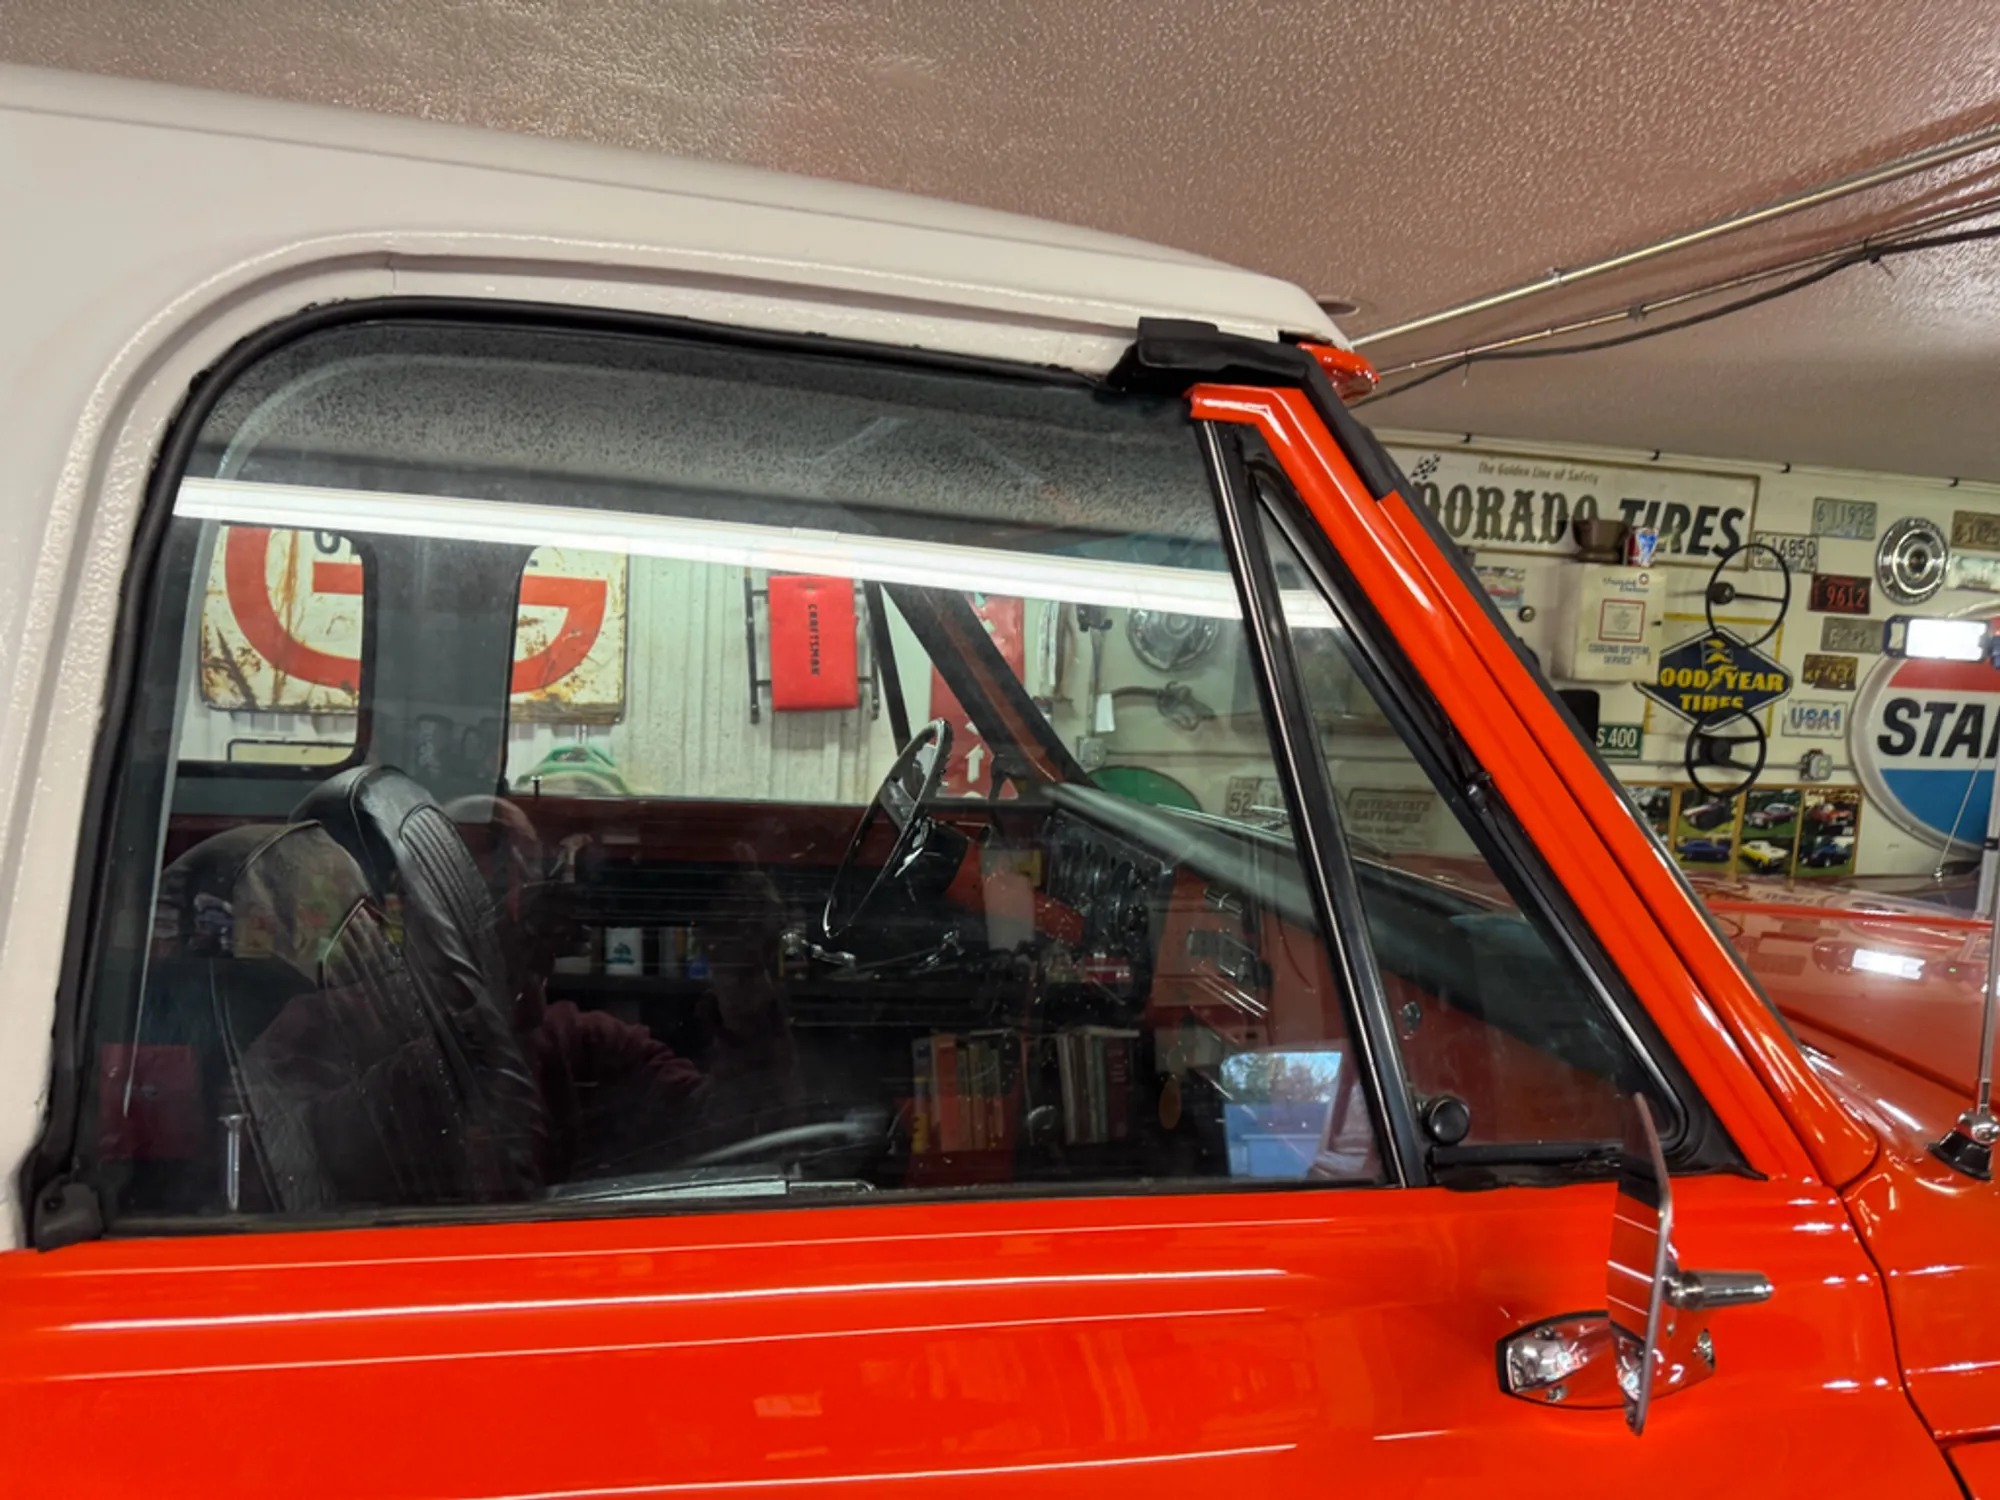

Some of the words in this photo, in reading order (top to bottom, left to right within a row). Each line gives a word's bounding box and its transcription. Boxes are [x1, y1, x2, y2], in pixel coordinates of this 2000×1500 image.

[1478, 462, 1495, 475] The
[1498, 463, 1530, 477] Golden
[1532, 465, 1552, 479] Line
[1553, 467, 1565, 480] of
[1567, 468, 1600, 485] Safety
[1619, 498, 1745, 559] TIRES
[1826, 582, 1867, 608] 9612
[808, 604, 820, 675] CRAFTSMAN
[1660, 667, 1785, 692] OODYEAR
[1679, 693, 1745, 712] TIRES
[1608, 727, 1638, 748] 400
